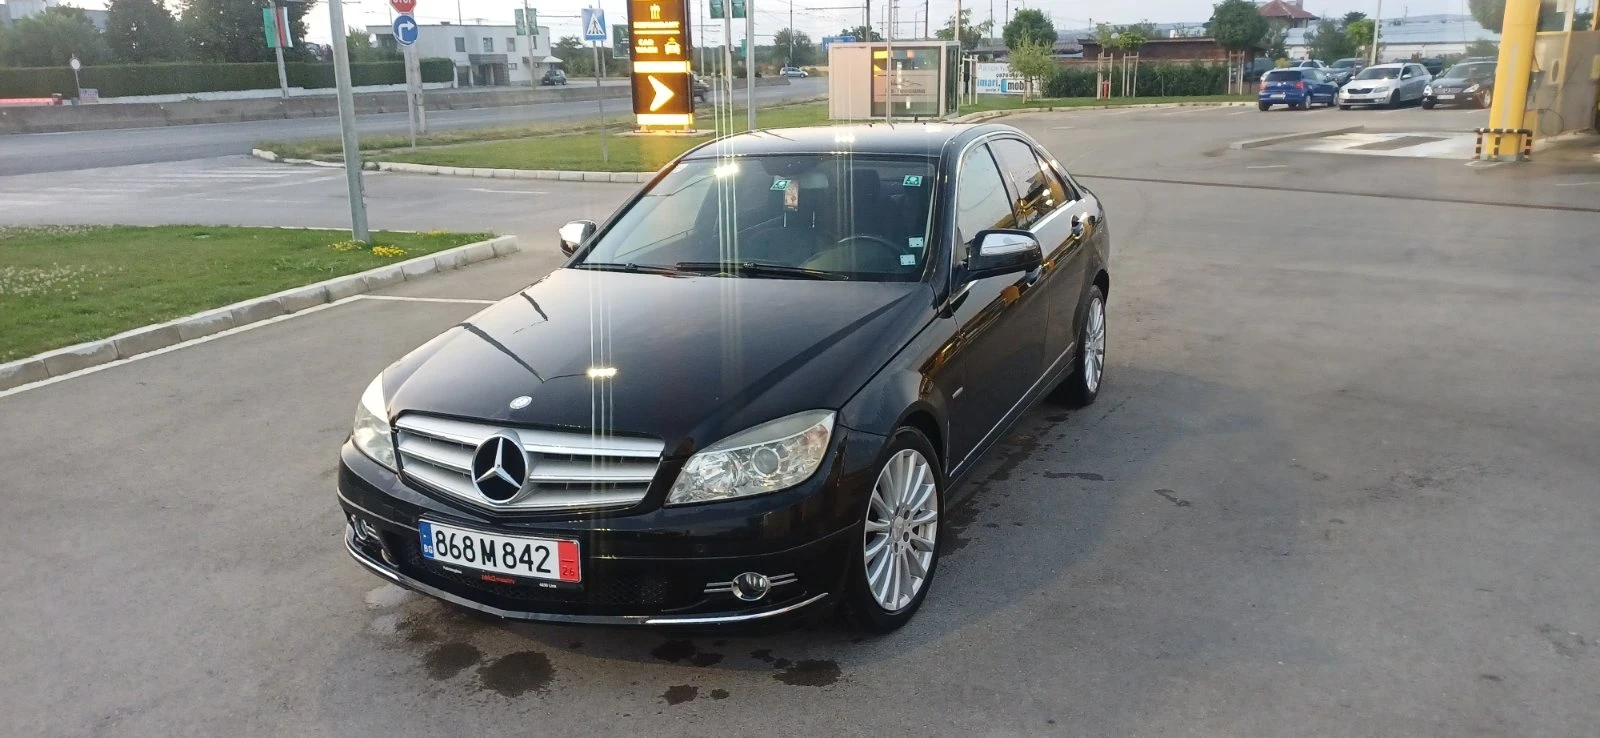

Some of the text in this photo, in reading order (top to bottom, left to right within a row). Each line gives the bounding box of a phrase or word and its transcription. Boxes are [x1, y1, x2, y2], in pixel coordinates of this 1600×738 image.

[1008, 81, 1025, 91] mob
[423, 530, 551, 573] BG 868 M 842
[562, 567, 575, 576] 26
